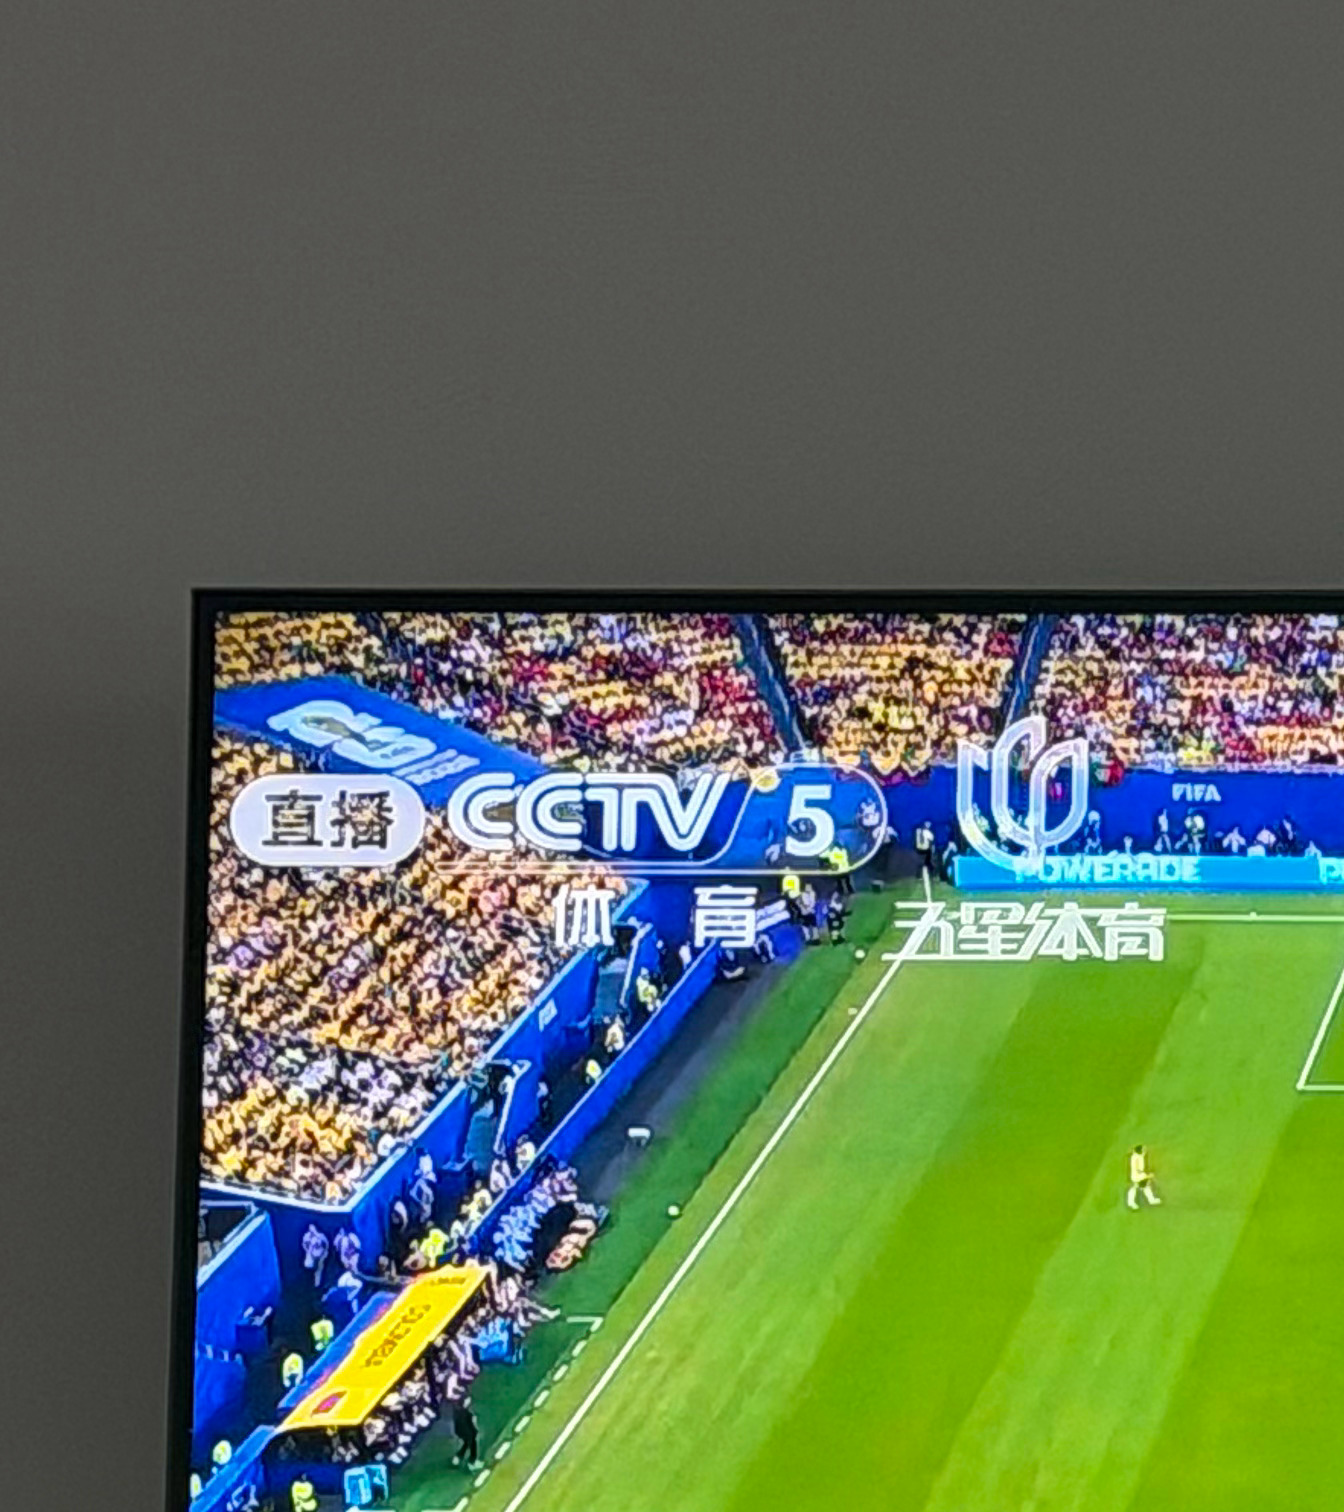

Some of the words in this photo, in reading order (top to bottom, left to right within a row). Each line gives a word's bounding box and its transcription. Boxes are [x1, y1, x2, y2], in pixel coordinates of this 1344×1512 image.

[261, 790, 395, 850] 直播
[447, 772, 732, 851] CCTV
[785, 785, 836, 857] 5
[551, 885, 758, 948] 体育
[882, 901, 1168, 962] 五星体育
